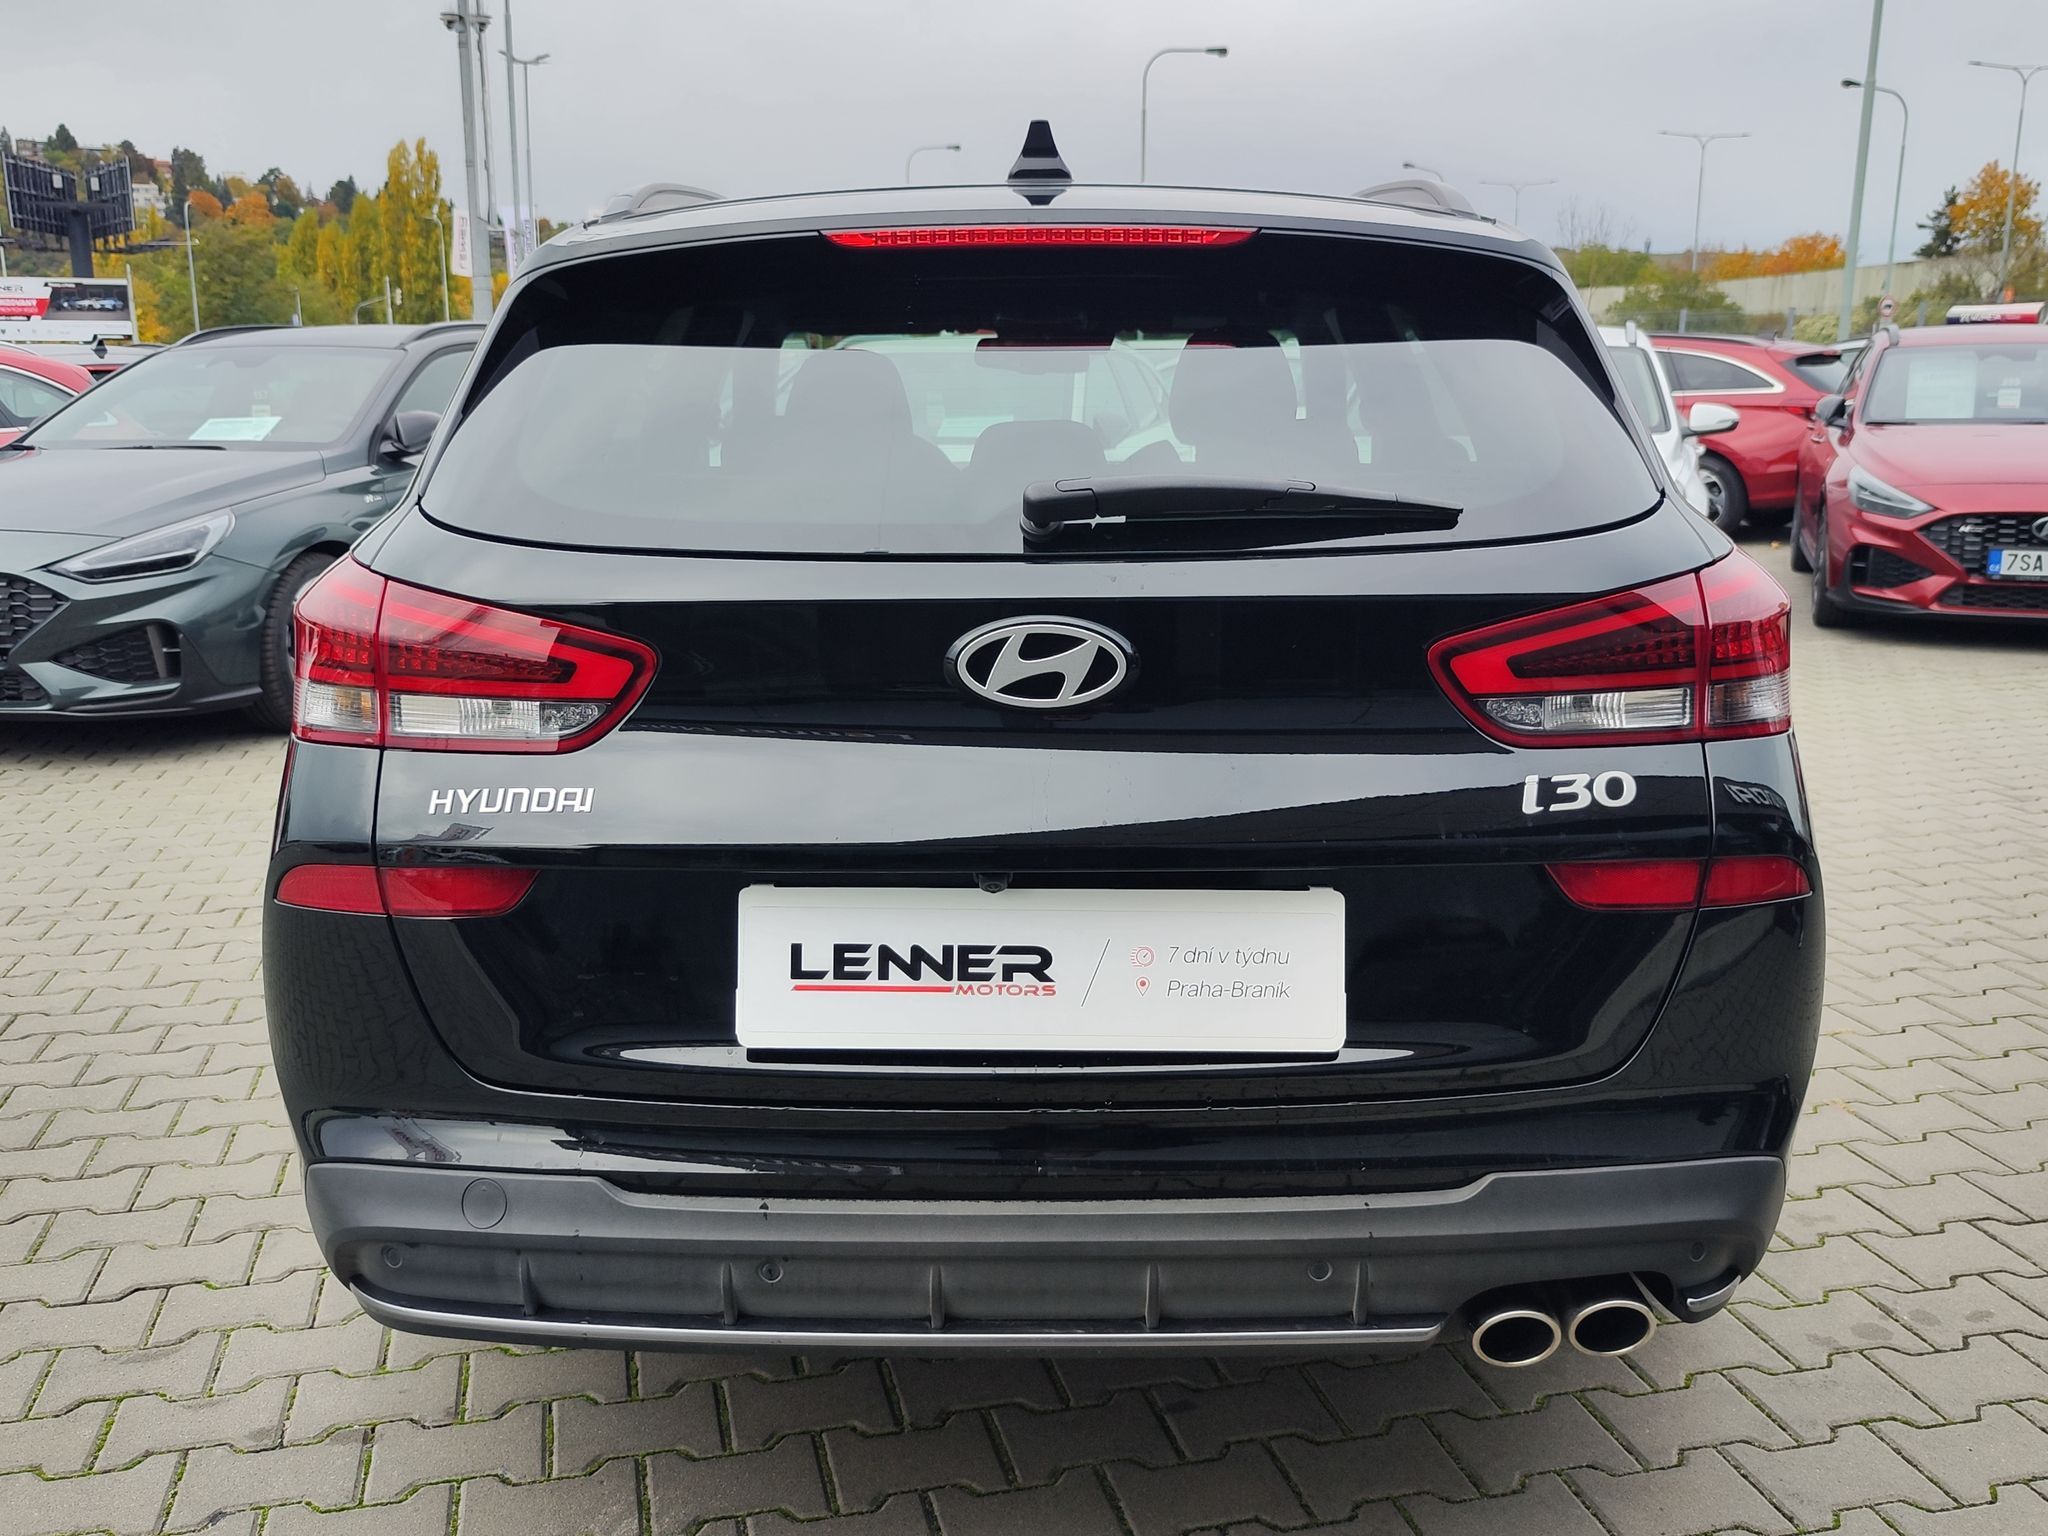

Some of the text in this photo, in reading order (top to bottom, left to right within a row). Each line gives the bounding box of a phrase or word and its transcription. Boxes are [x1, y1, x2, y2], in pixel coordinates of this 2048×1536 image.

[2006, 553, 2044, 572] 7SA
[428, 787, 595, 815] HYUNDAI
[790, 943, 1055, 982] LENNER
[1168, 946, 1290, 969] 7 dní v týdnu
[955, 983, 1056, 997] MOTORS
[1167, 980, 1290, 998] Praha-Braník
